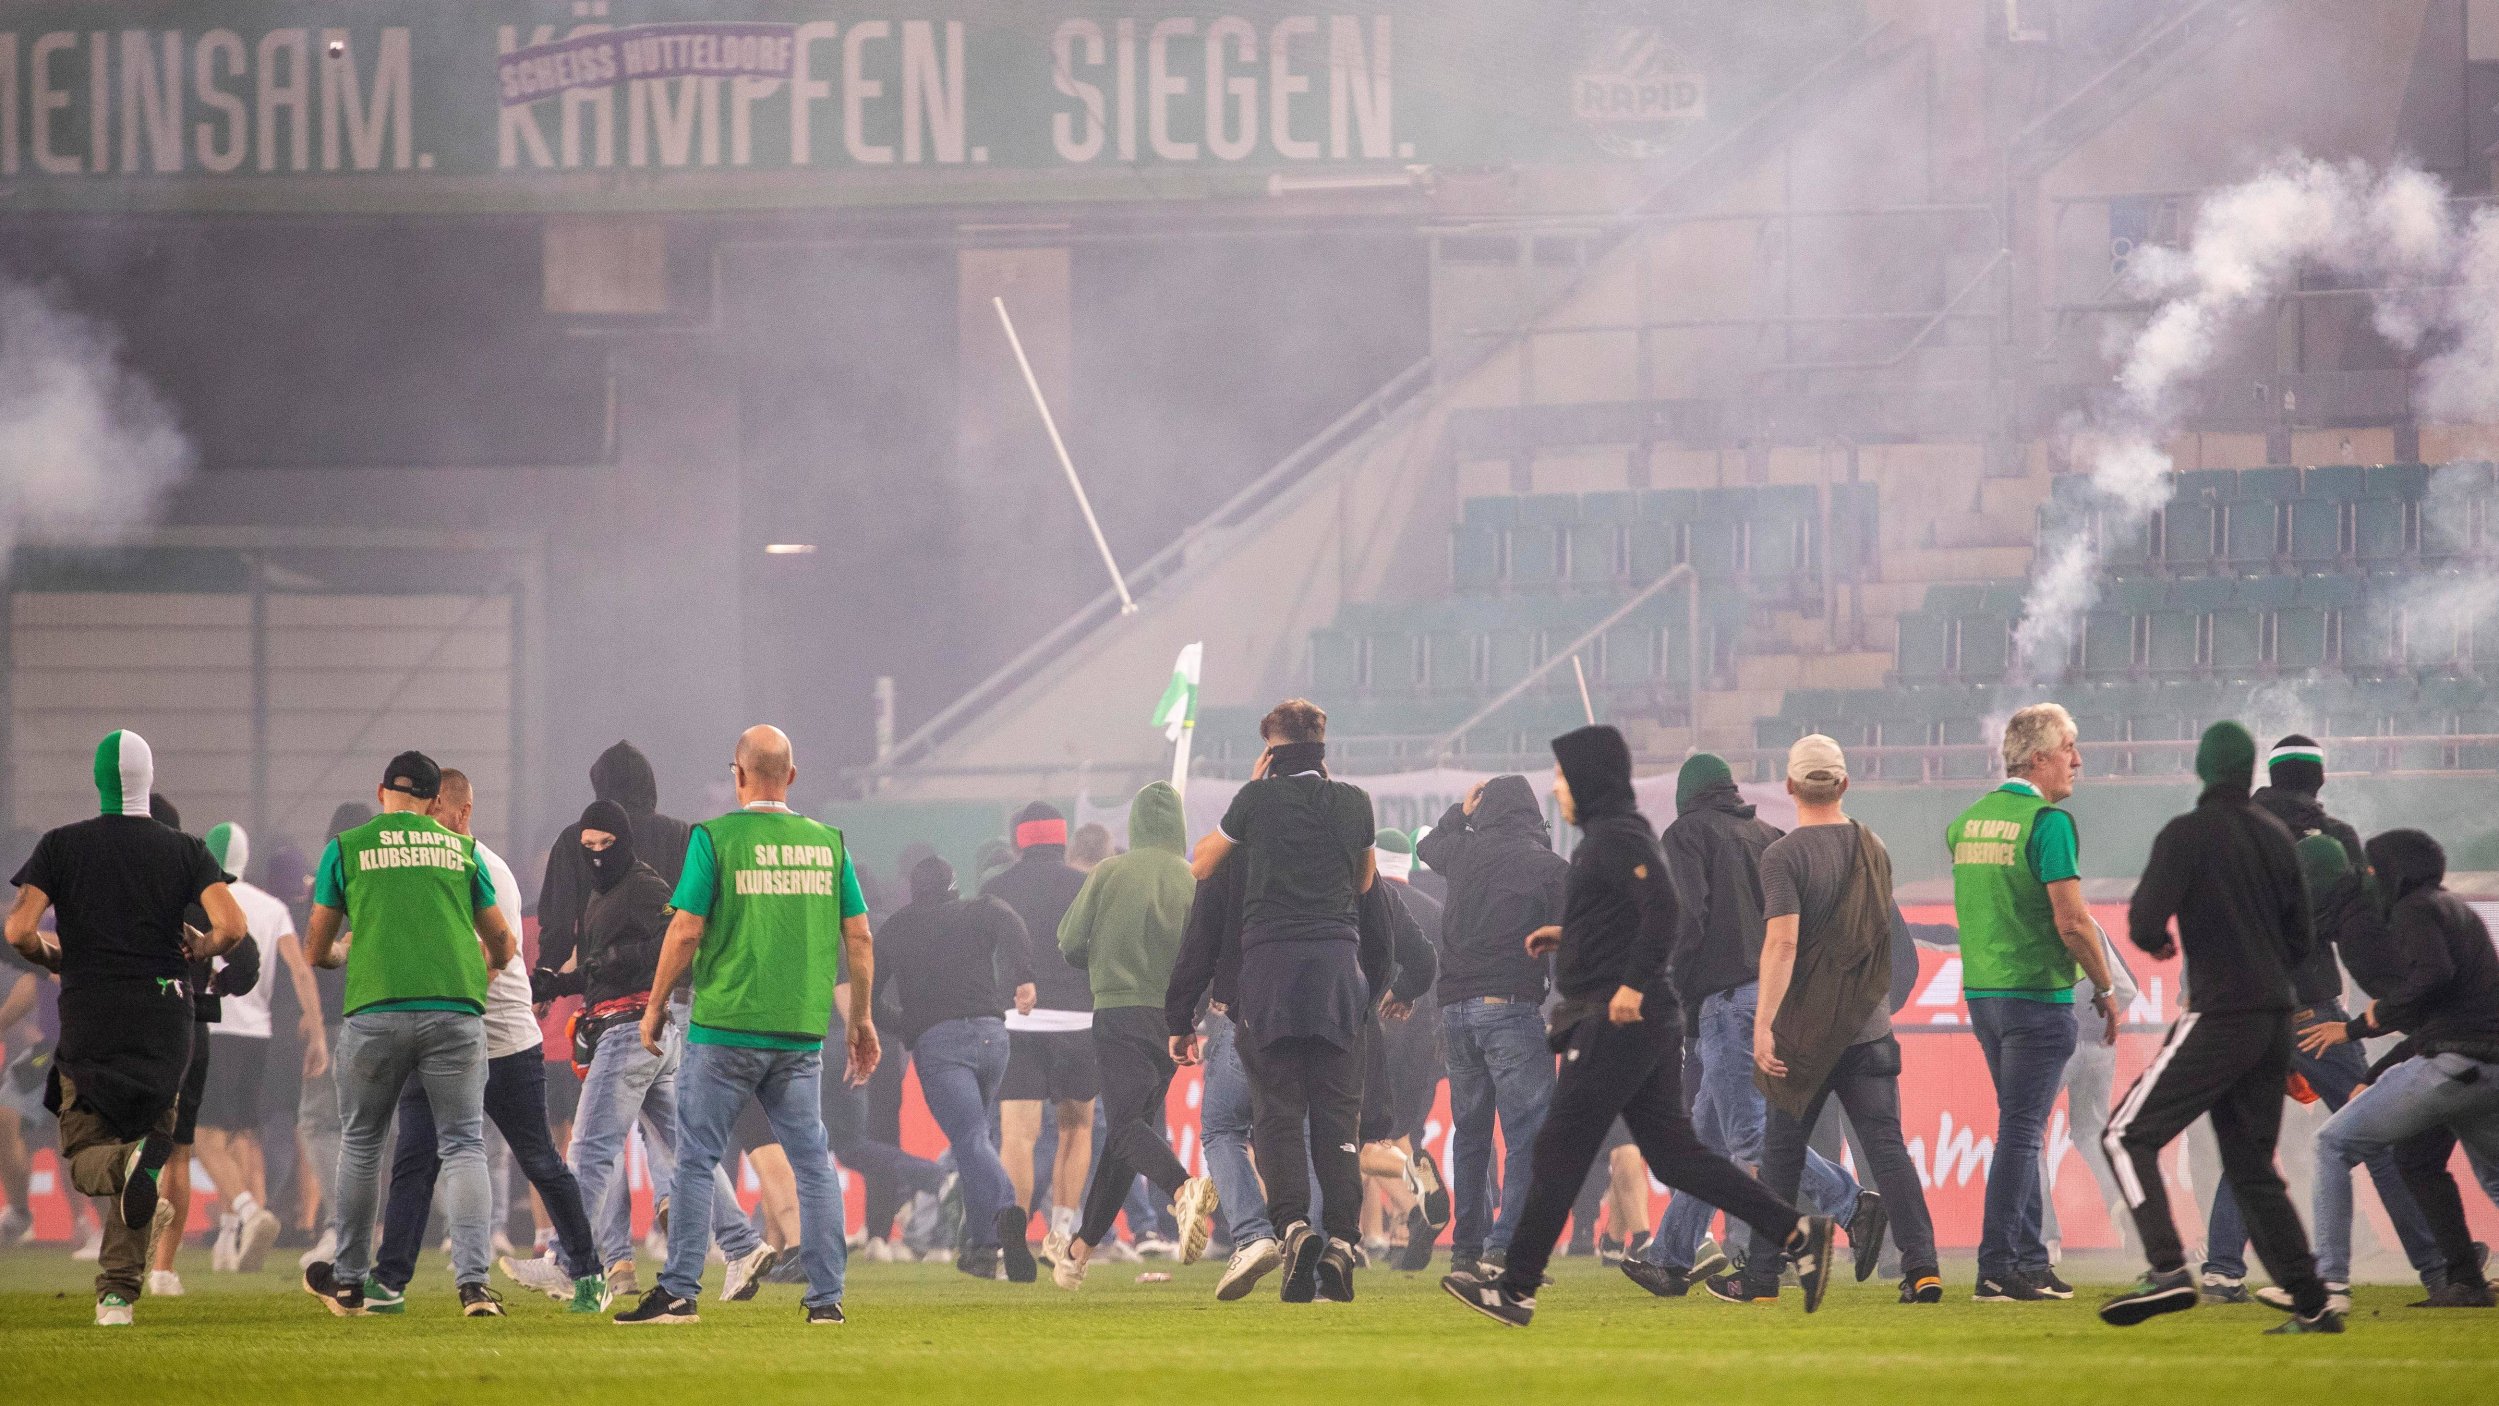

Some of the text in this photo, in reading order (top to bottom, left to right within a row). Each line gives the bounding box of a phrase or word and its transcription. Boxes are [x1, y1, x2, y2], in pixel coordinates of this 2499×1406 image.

[500, 44, 617, 98] SCHEISS
[0, 26, 434, 173] EINSAM.
[1051, 14, 1416, 163] SIEGEN.
[1582, 79, 1699, 112] RAPID
[379, 830, 462, 853] SK RAPID
[1963, 819, 2021, 841] SK RAPID
[359, 847, 465, 871] KLUBSERVICE
[754, 844, 834, 867] SK RAPID
[735, 869, 833, 896] KLUBSERVICE
